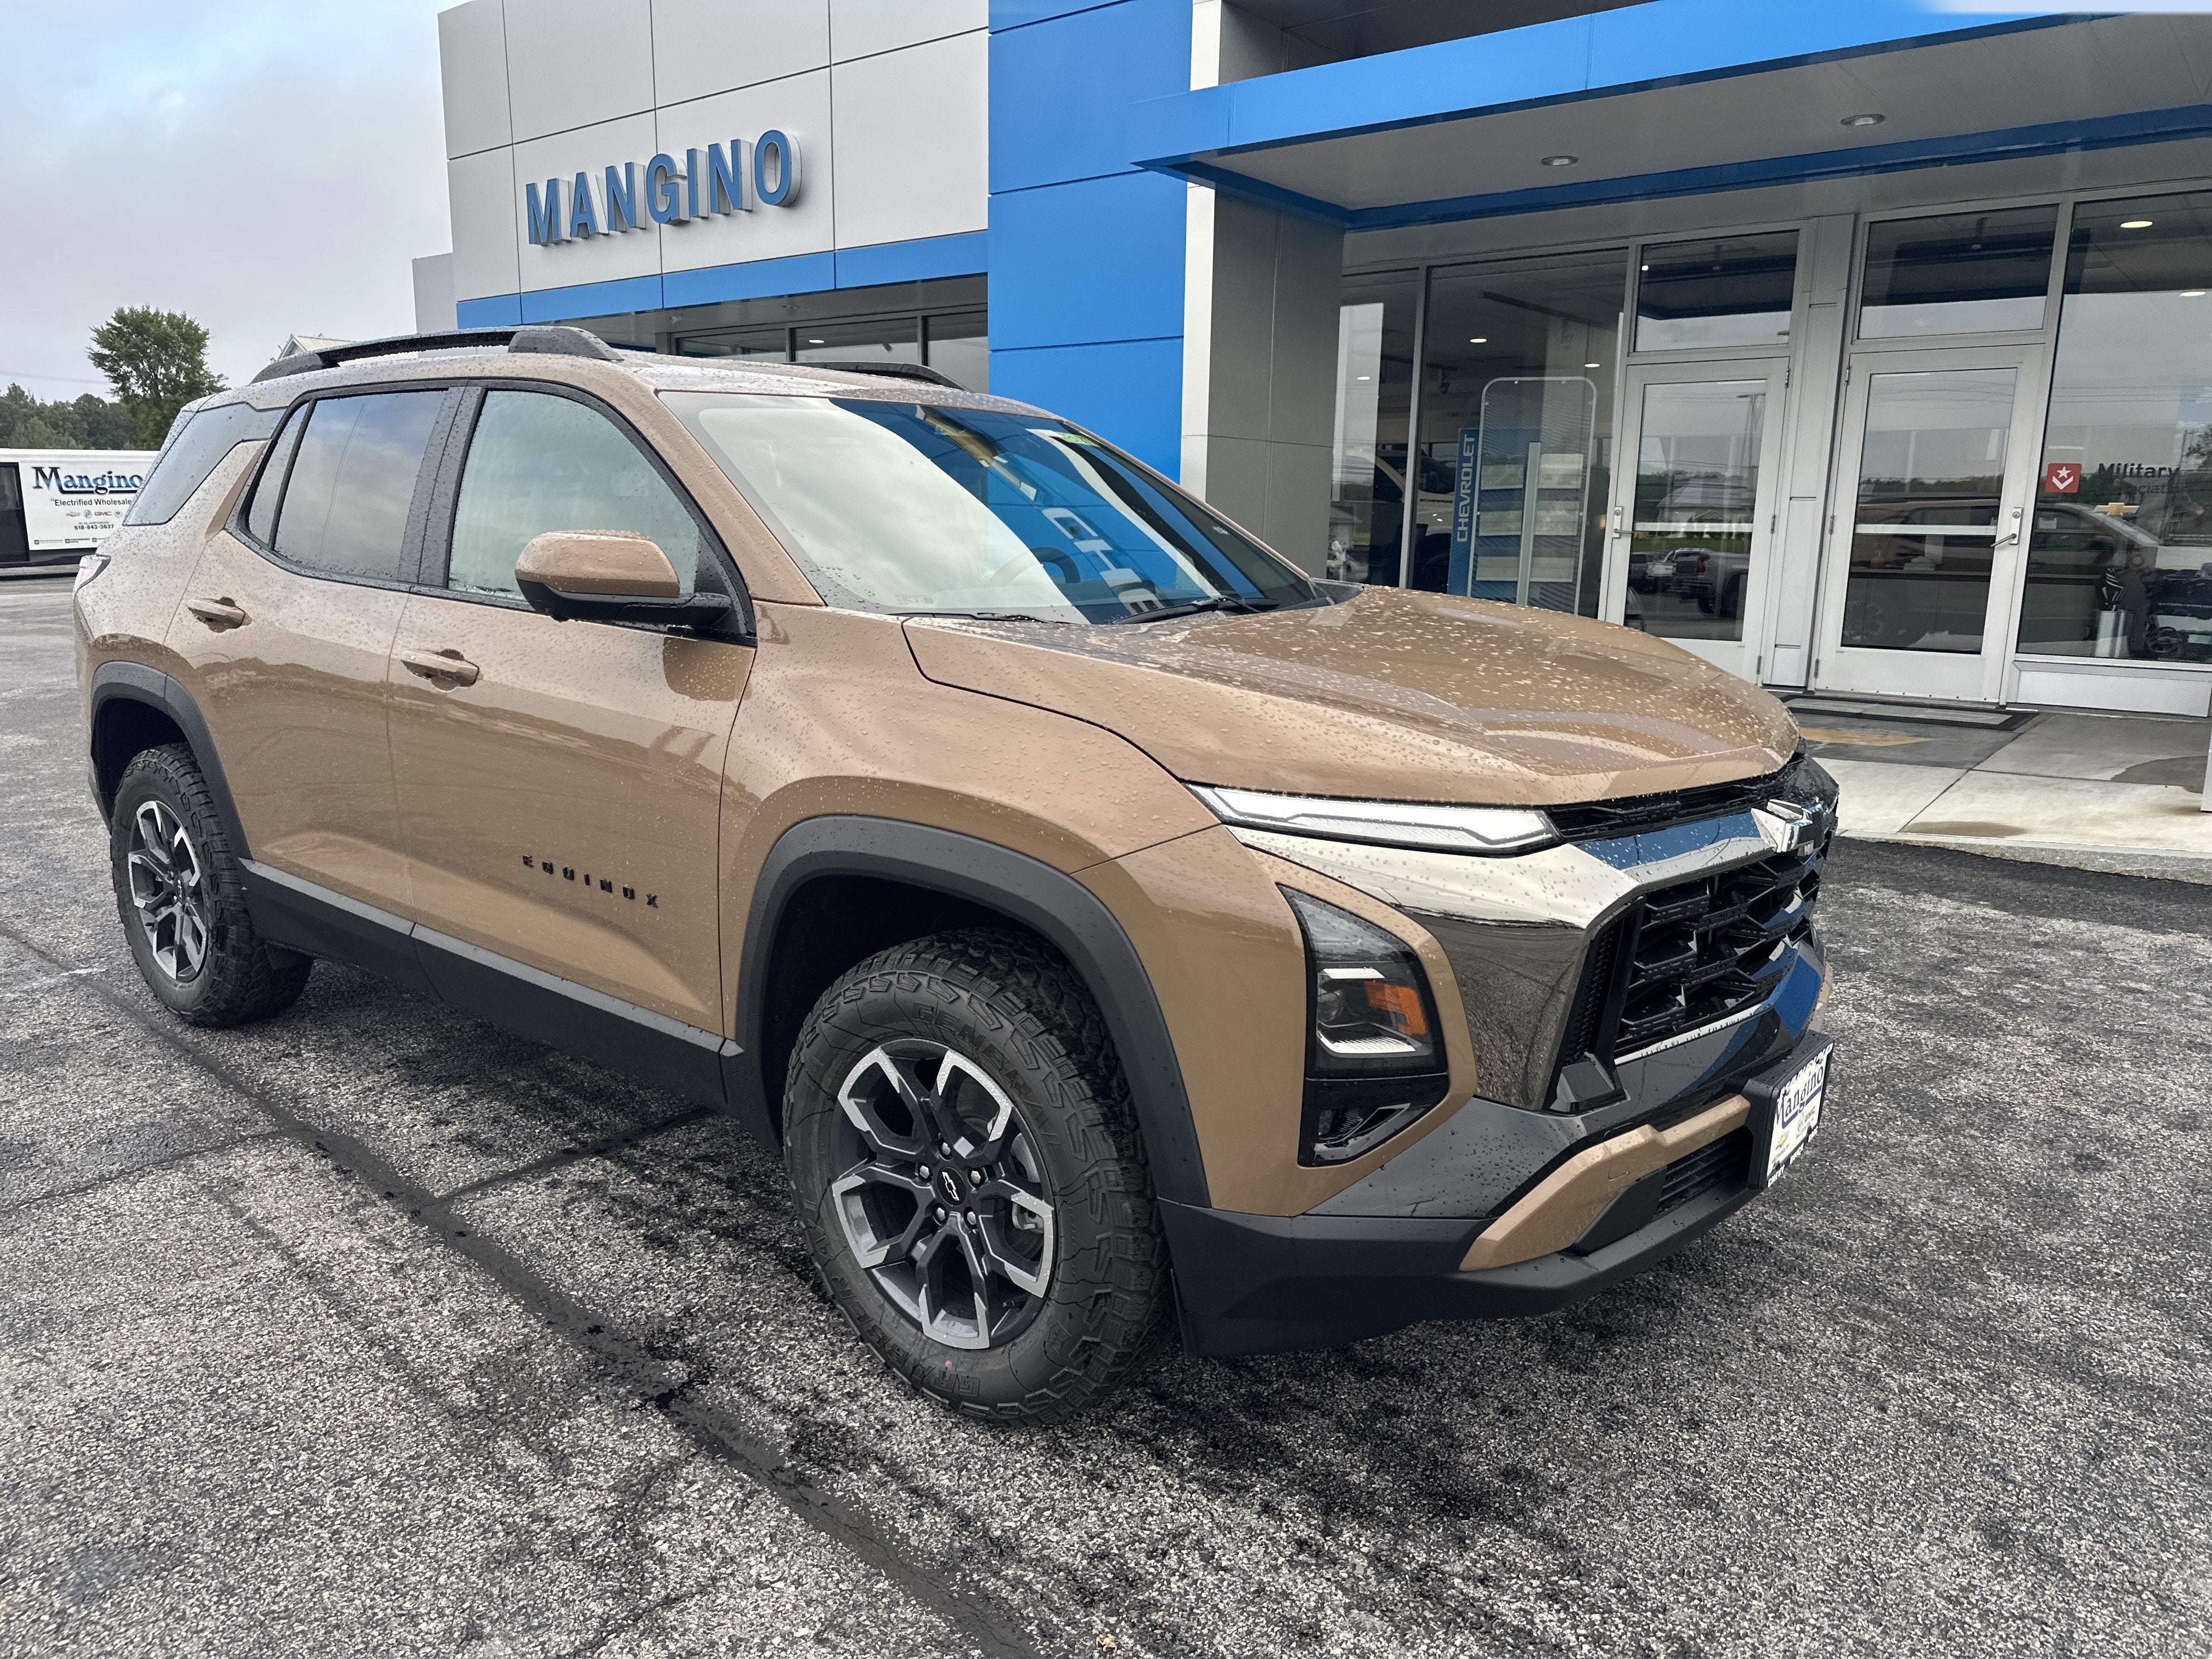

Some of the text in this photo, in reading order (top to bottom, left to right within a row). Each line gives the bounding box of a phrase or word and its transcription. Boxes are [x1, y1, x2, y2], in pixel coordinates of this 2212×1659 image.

[526, 129, 800, 246] MANGINO
[31, 466, 143, 494] Mangino
[1457, 433, 1476, 543] CHEVROLET
[2097, 462, 2181, 478] Military
[523, 854, 658, 909] EQUINOX
[911, 1001, 1062, 1146] GENERAL
[1775, 1065, 1824, 1129] Mangino
[831, 1275, 981, 1397] GRABBER
